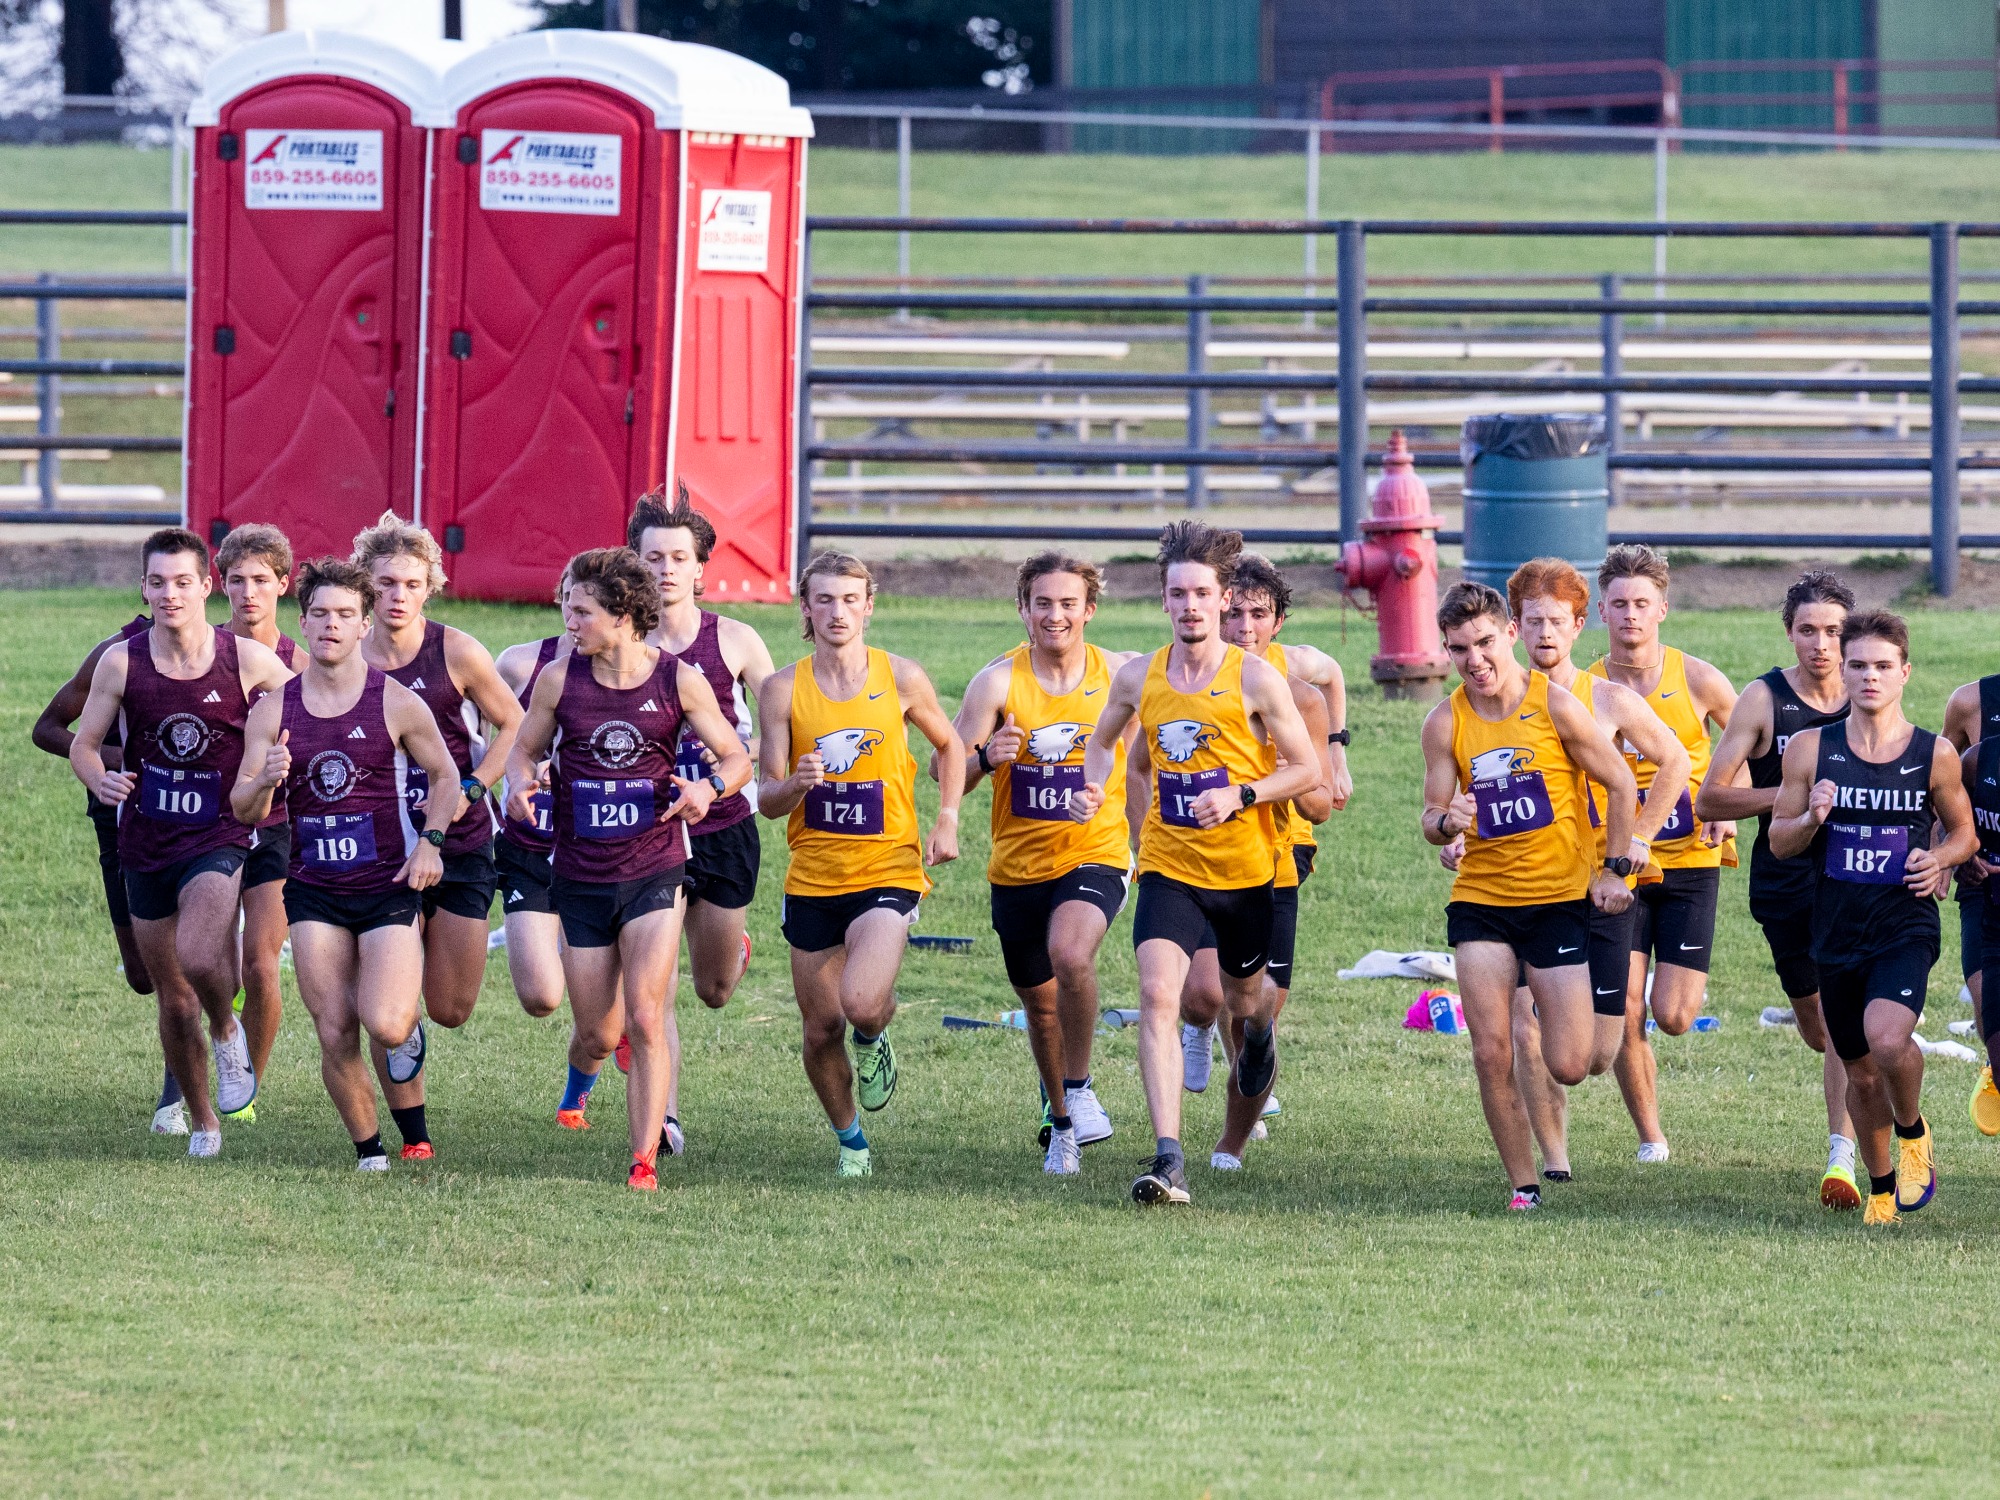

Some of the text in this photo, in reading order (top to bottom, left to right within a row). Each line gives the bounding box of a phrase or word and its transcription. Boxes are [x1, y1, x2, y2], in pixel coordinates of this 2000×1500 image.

[251, 170, 377, 184] 859-255-6605
[486, 170, 615, 189] 859-255-6605
[148, 765, 170, 777] TIMING
[1016, 764, 1039, 773] TIMING
[1200, 771, 1218, 779] KING
[1472, 774, 1533, 790] TIMING KING
[156, 788, 202, 814] 110
[1026, 786, 1073, 810] 164
[1173, 794, 1197, 817] 17
[1832, 786, 1926, 811] IKEVILLE
[589, 803, 639, 827] 120
[822, 801, 867, 825] 174
[1488, 796, 1536, 827] 170
[1833, 825, 1856, 833] TIMING
[314, 838, 358, 861] 119
[1843, 848, 1892, 873] 187
